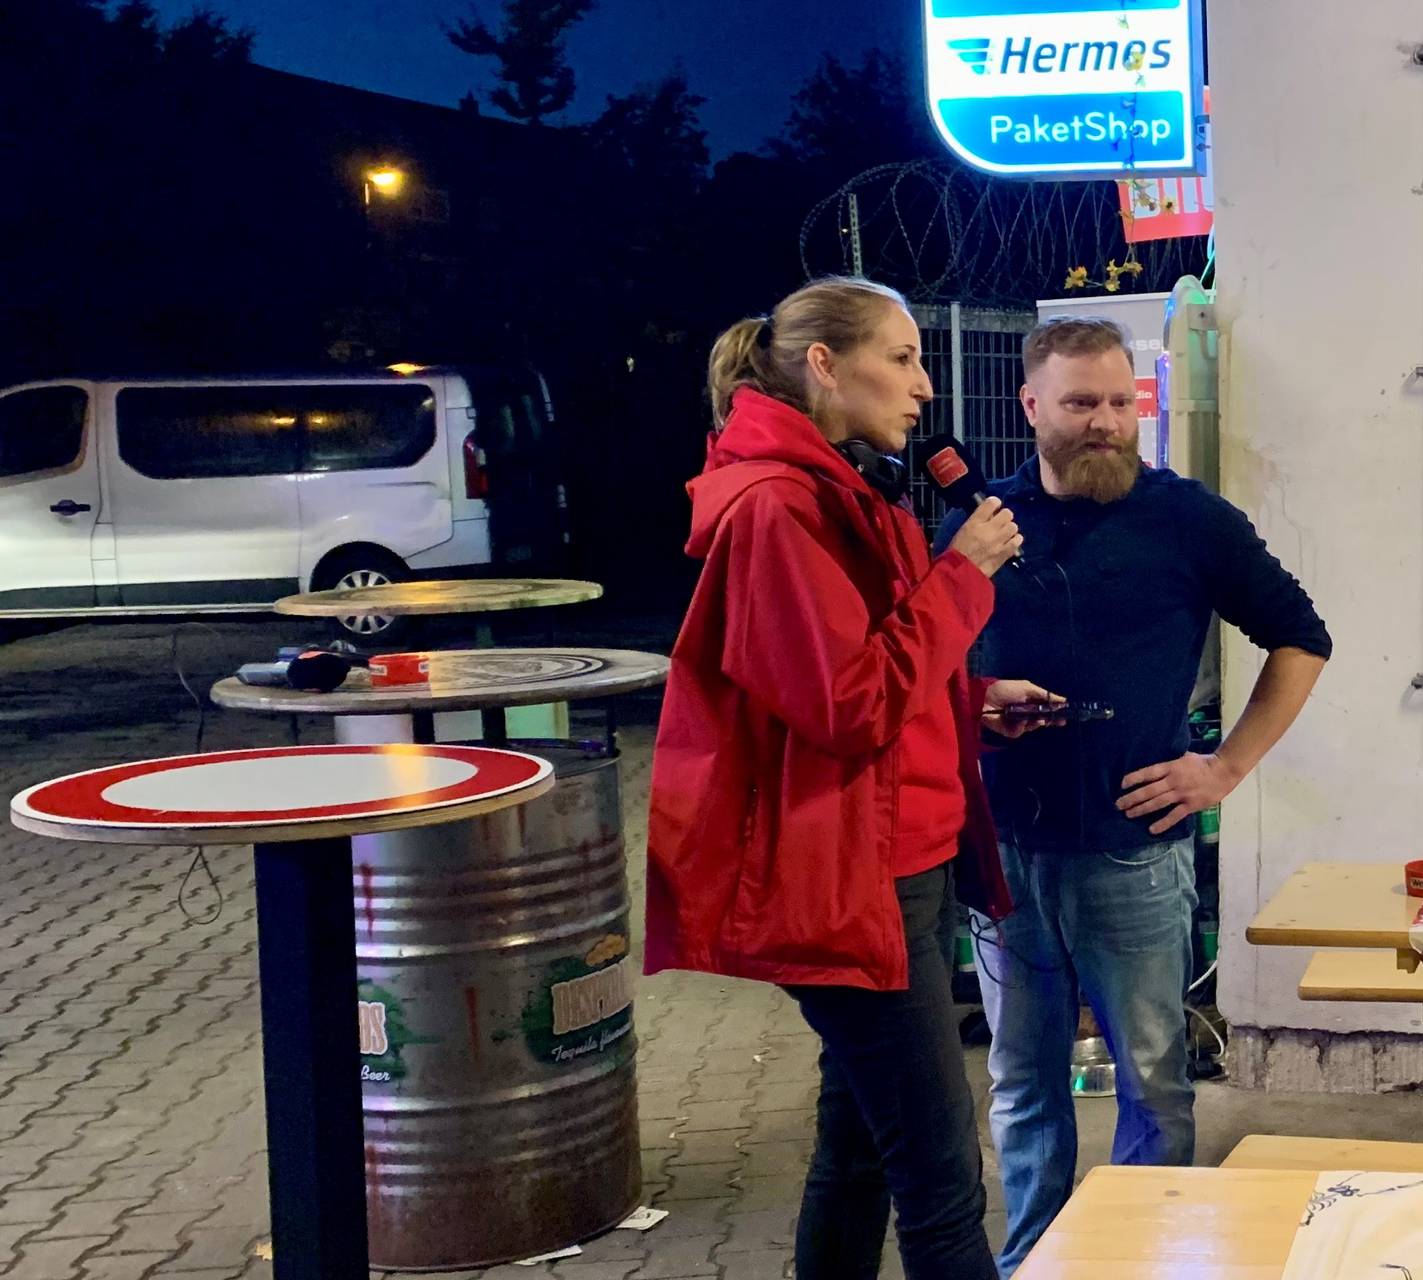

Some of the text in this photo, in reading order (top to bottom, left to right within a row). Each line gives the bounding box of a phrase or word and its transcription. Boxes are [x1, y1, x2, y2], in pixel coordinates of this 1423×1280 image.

[999, 37, 1172, 74] Hermes
[990, 111, 1172, 146] PaketShop
[360, 1064, 391, 1081] Beer
